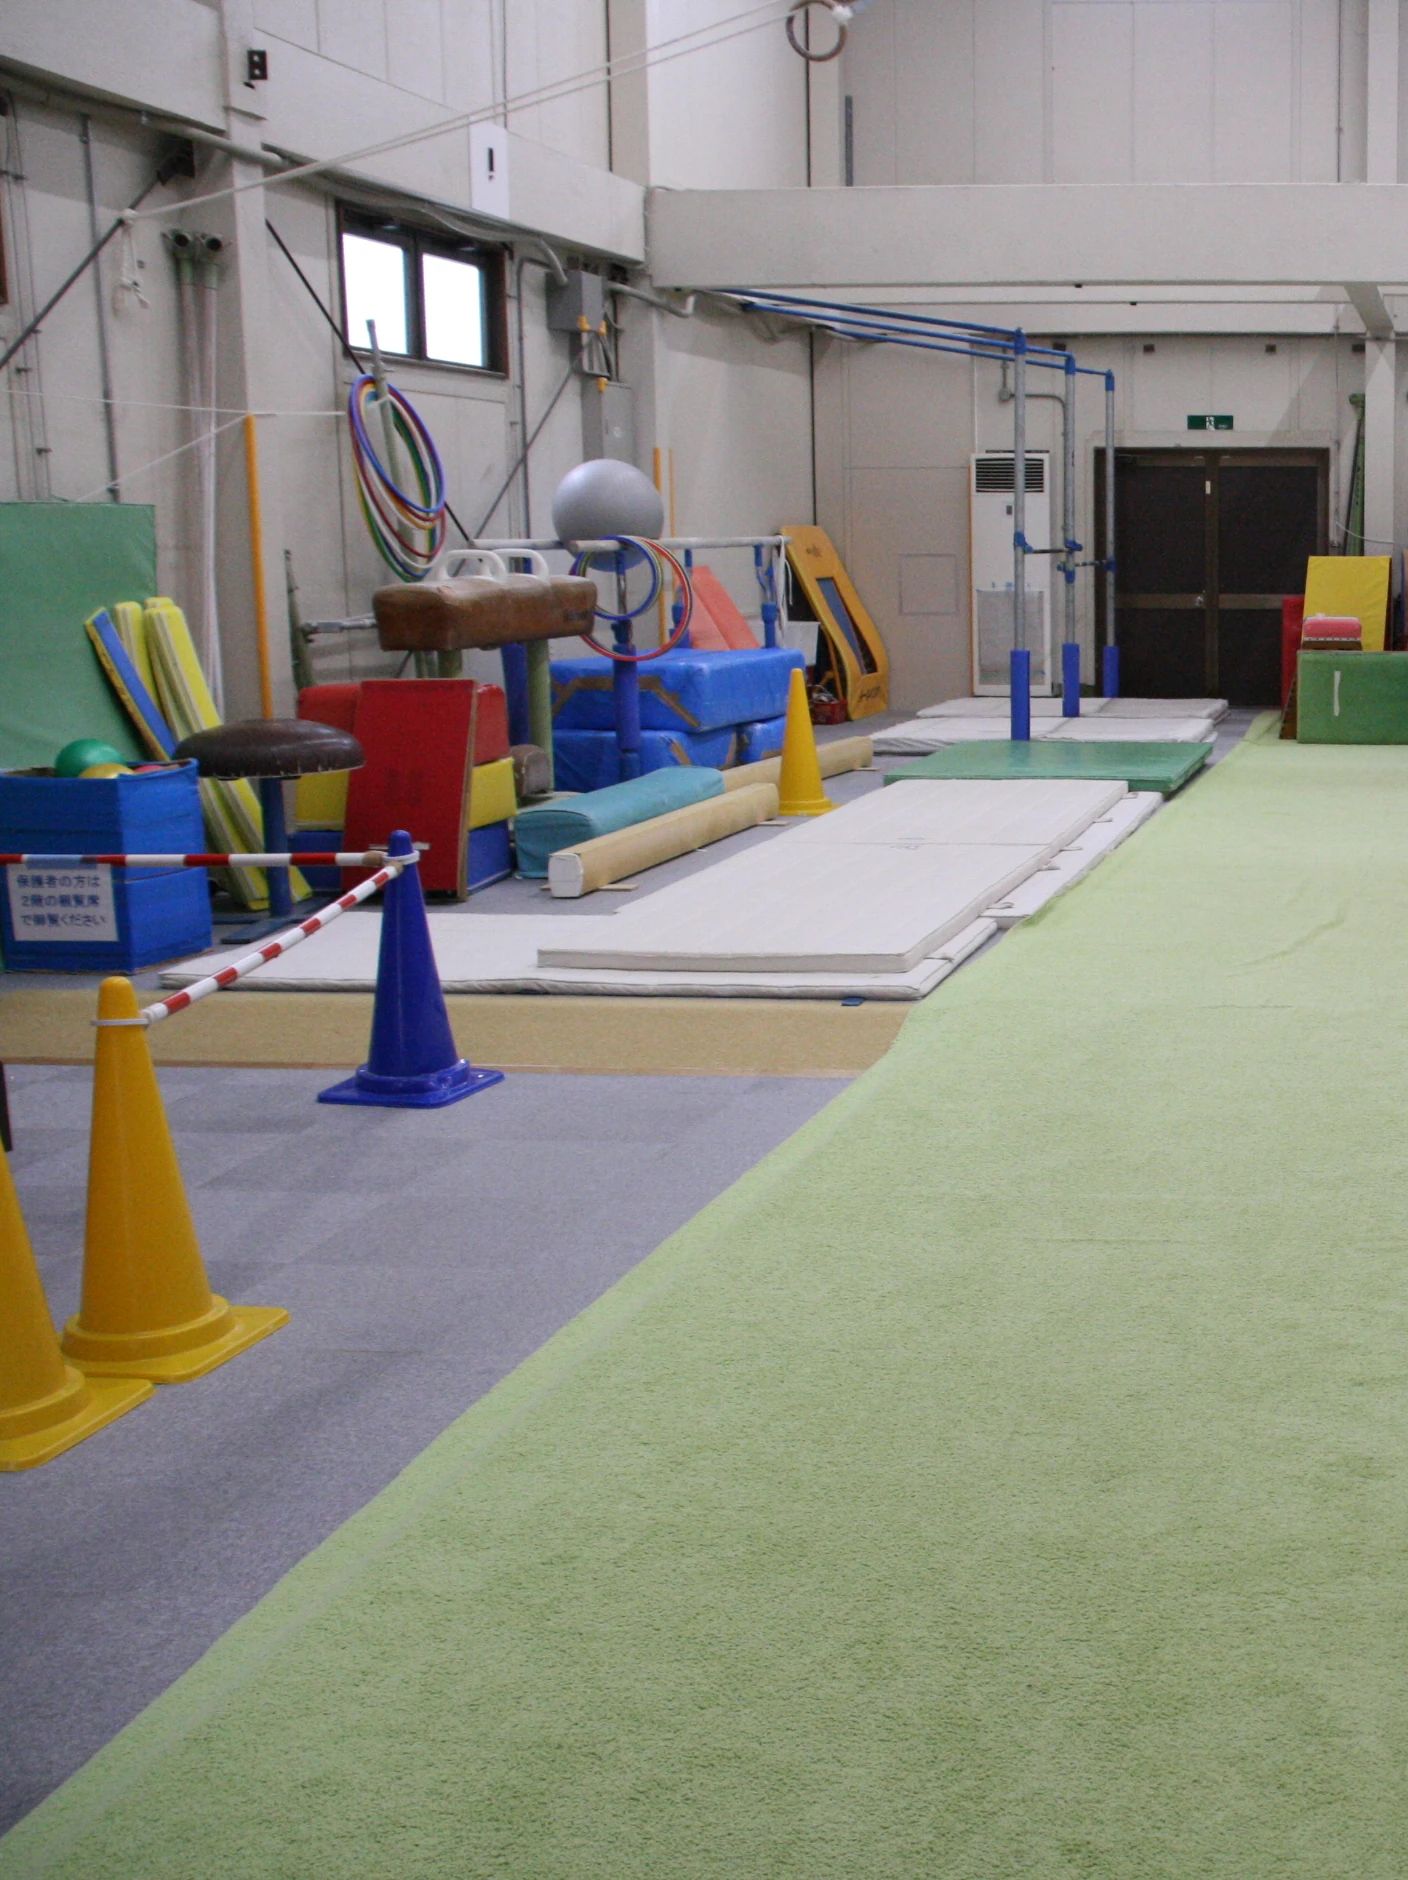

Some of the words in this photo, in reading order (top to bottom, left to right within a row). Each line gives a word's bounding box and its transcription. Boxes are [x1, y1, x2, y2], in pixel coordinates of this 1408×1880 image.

[16, 874, 100, 888] 保護者の方は
